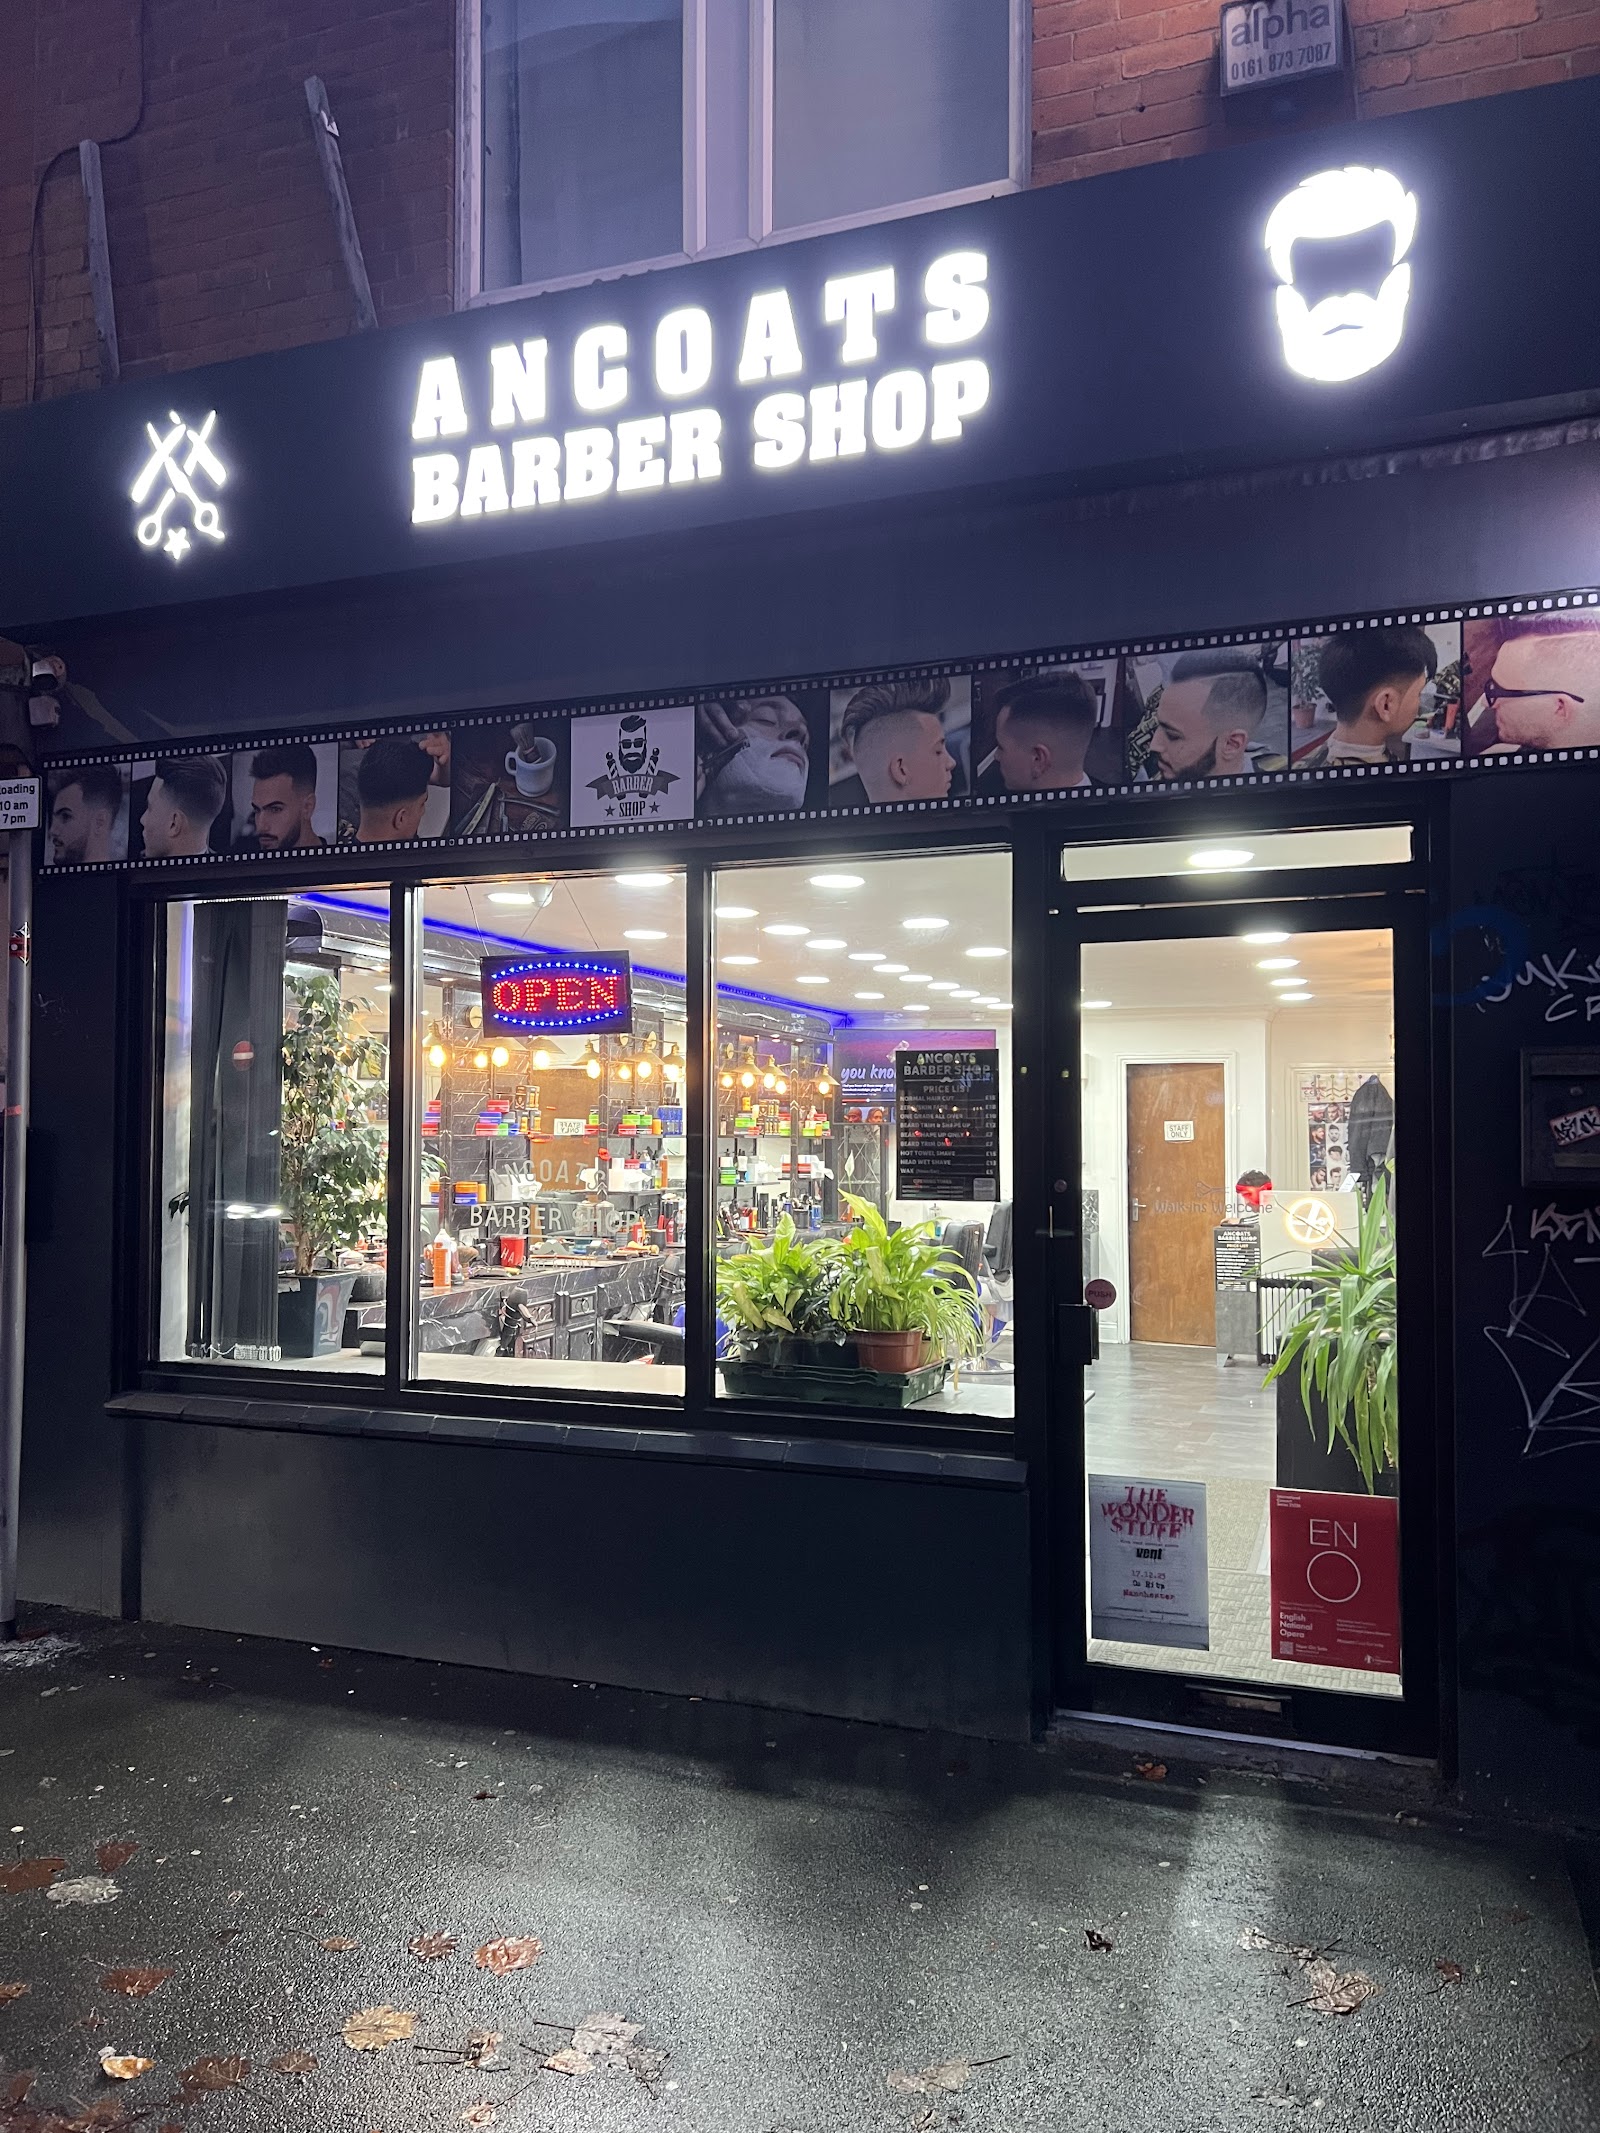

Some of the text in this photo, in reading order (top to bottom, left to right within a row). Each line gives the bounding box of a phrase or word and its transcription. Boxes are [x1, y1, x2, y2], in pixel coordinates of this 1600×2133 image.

[1231, 0, 1330, 50] alpha
[1231, 42, 1332, 80] 0161 873 7087
[411, 251, 990, 440] ANCOATS
[410, 359, 990, 524] BARBER SHOP
[0, 784, 35, 795] oading
[612, 775, 654, 795] BARBER
[14, 802, 29, 810] am
[619, 801, 646, 818] SHOP
[11, 815, 26, 825] pm
[492, 976, 618, 1012] OPEN
[917, 1052, 976, 1064] ANCOATS
[840, 1064, 896, 1084] you kno
[903, 1064, 991, 1076] BARBER SHOP
[923, 1085, 970, 1093] PRICE LIST
[1169, 1124, 1189, 1132] STAFF
[489, 1159, 606, 1191] ANCOATS
[1211, 1201, 1273, 1214] Welcome
[470, 1205, 639, 1234] BARBER SHOP
[1088, 1290, 1112, 1298] PUSH
[1124, 1486, 1168, 1503] THE
[1101, 1502, 1195, 1526] WONDER
[1111, 1517, 1183, 1538] STUFF
[1309, 1518, 1357, 1549] EN
[1136, 1548, 1163, 1560] vent
[1307, 1551, 1361, 1603] O
[1123, 1589, 1176, 1600] Manchester
[1279, 1612, 1306, 1622] English
[1279, 1620, 1313, 1631] National
[1279, 1629, 1305, 1639] Opera
